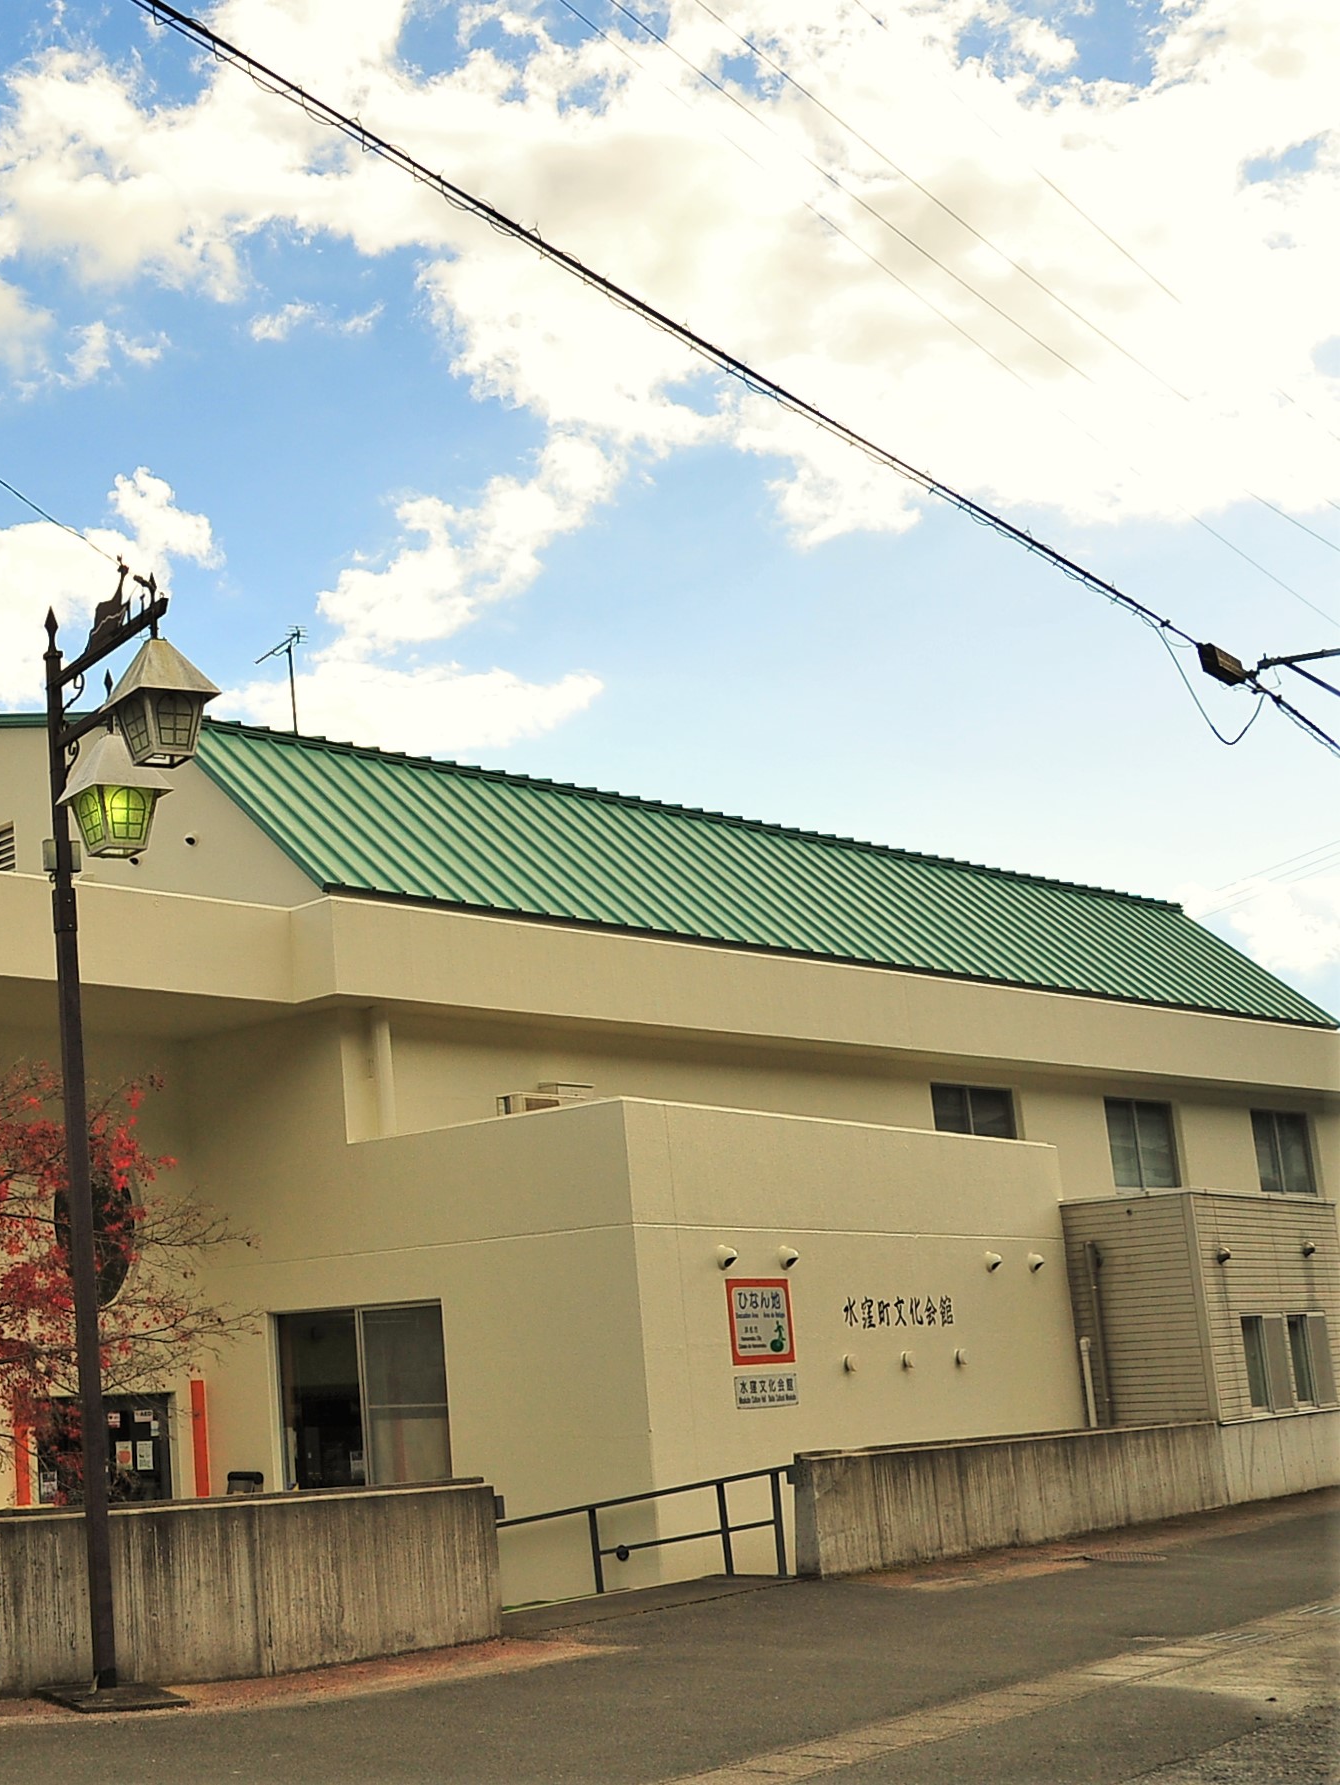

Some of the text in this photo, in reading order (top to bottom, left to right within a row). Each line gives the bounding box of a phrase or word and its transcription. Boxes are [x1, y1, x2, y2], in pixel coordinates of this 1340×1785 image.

[737, 1291, 781, 1310] ひなん地
[843, 1295, 954, 1329] 水窪町文化会館
